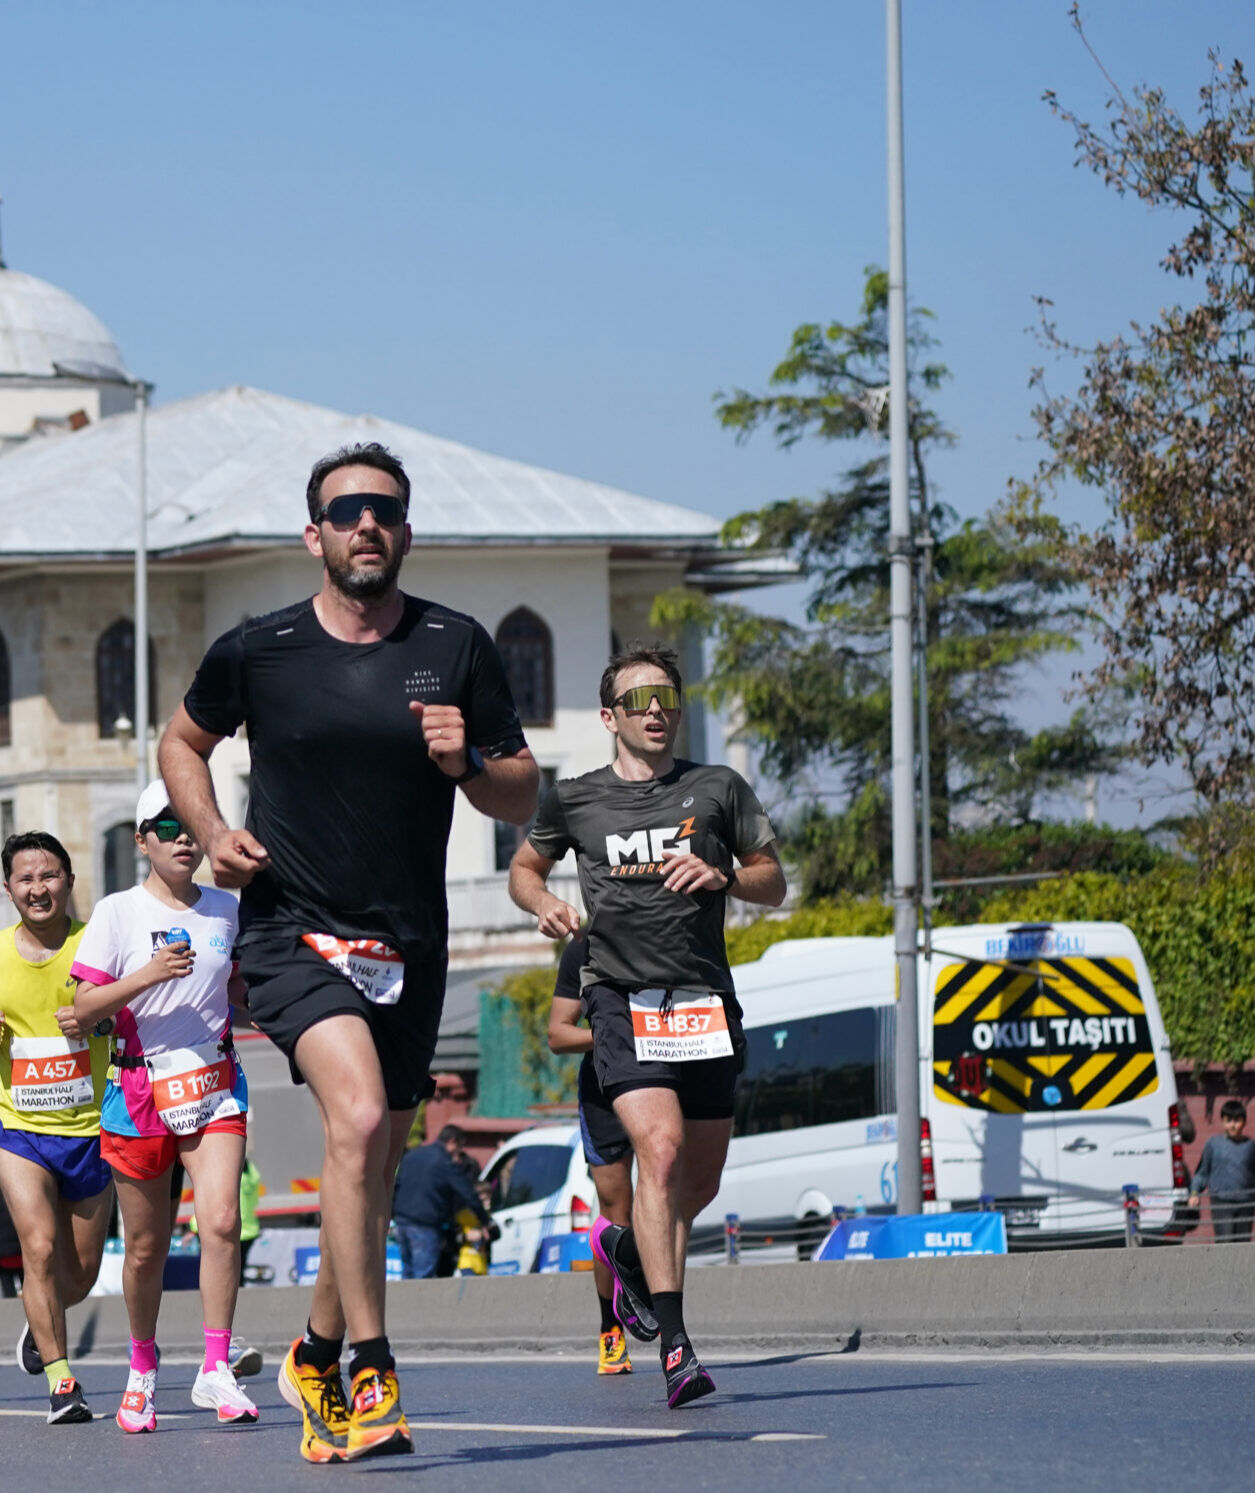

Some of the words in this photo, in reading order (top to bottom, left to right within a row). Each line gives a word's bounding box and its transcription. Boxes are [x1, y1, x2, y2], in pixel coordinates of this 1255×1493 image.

[610, 861, 665, 877] ENDURA
[644, 1014, 661, 1031] B
[664, 1013, 712, 1033] 1837
[972, 1020, 1046, 1051] OKUL
[1049, 1016, 1137, 1051] TAŞITI
[648, 1047, 708, 1058] MARATHON
[24, 1062, 40, 1080] A
[42, 1059, 77, 1079] 457
[167, 1080, 185, 1100] B
[187, 1069, 220, 1095] 1192
[21, 1095, 75, 1107] MARATHON
[169, 1103, 202, 1120] ISTANBU
[171, 1109, 215, 1132] MARAON
[924, 1231, 973, 1248] ELITE
